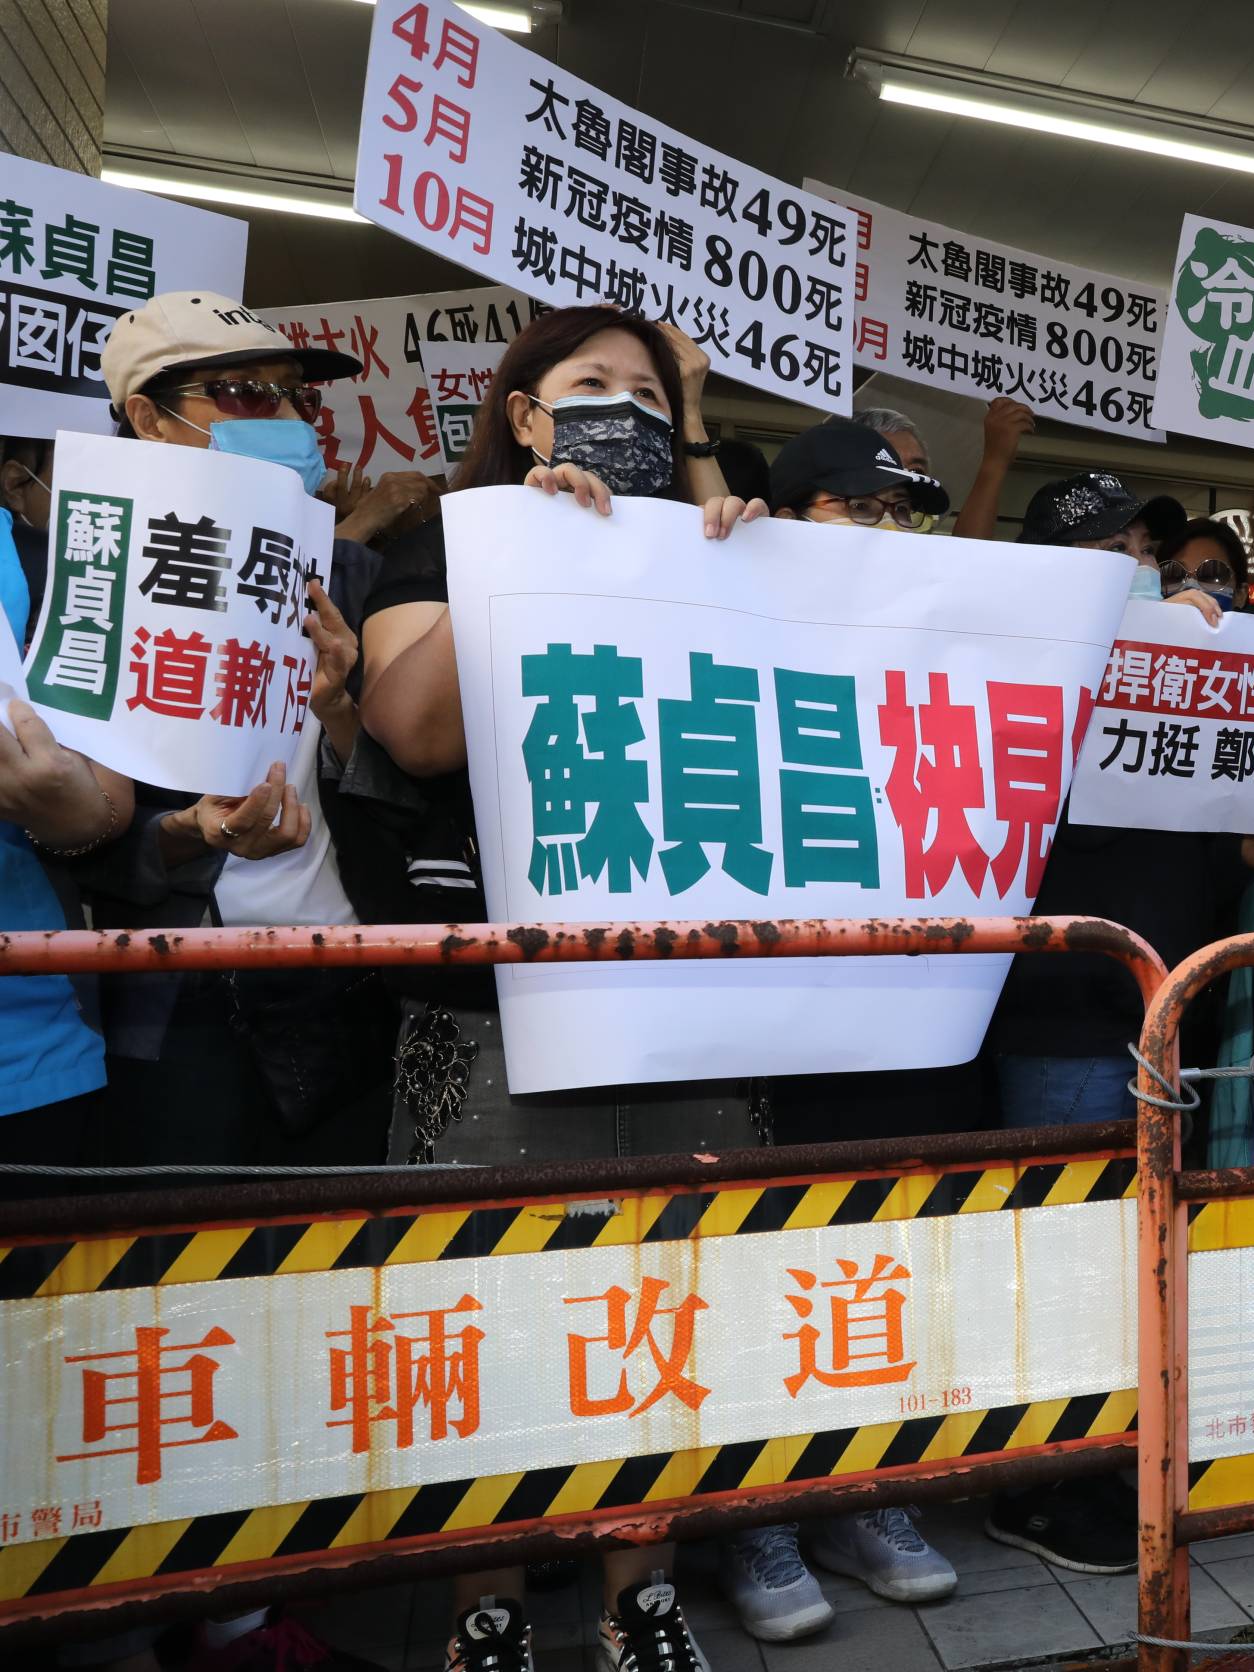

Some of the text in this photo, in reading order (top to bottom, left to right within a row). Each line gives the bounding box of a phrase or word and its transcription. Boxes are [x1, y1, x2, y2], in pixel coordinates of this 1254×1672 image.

[382, 73, 472, 164] 5月
[391, 2, 848, 268] 4月 太魯閣事故49死
[378, 153, 843, 398] 10月 城中城火災46死
[907, 232, 1157, 333] 太魯閣事故49死
[902, 330, 1154, 430] 城中城火災46死
[43, 498, 125, 696] 蘇貞昌
[125, 625, 276, 729] 道歉
[1099, 718, 1202, 779] 力挺
[56, 1253, 918, 1486] 車輛改道
[897, 1386, 974, 1414] 101-183
